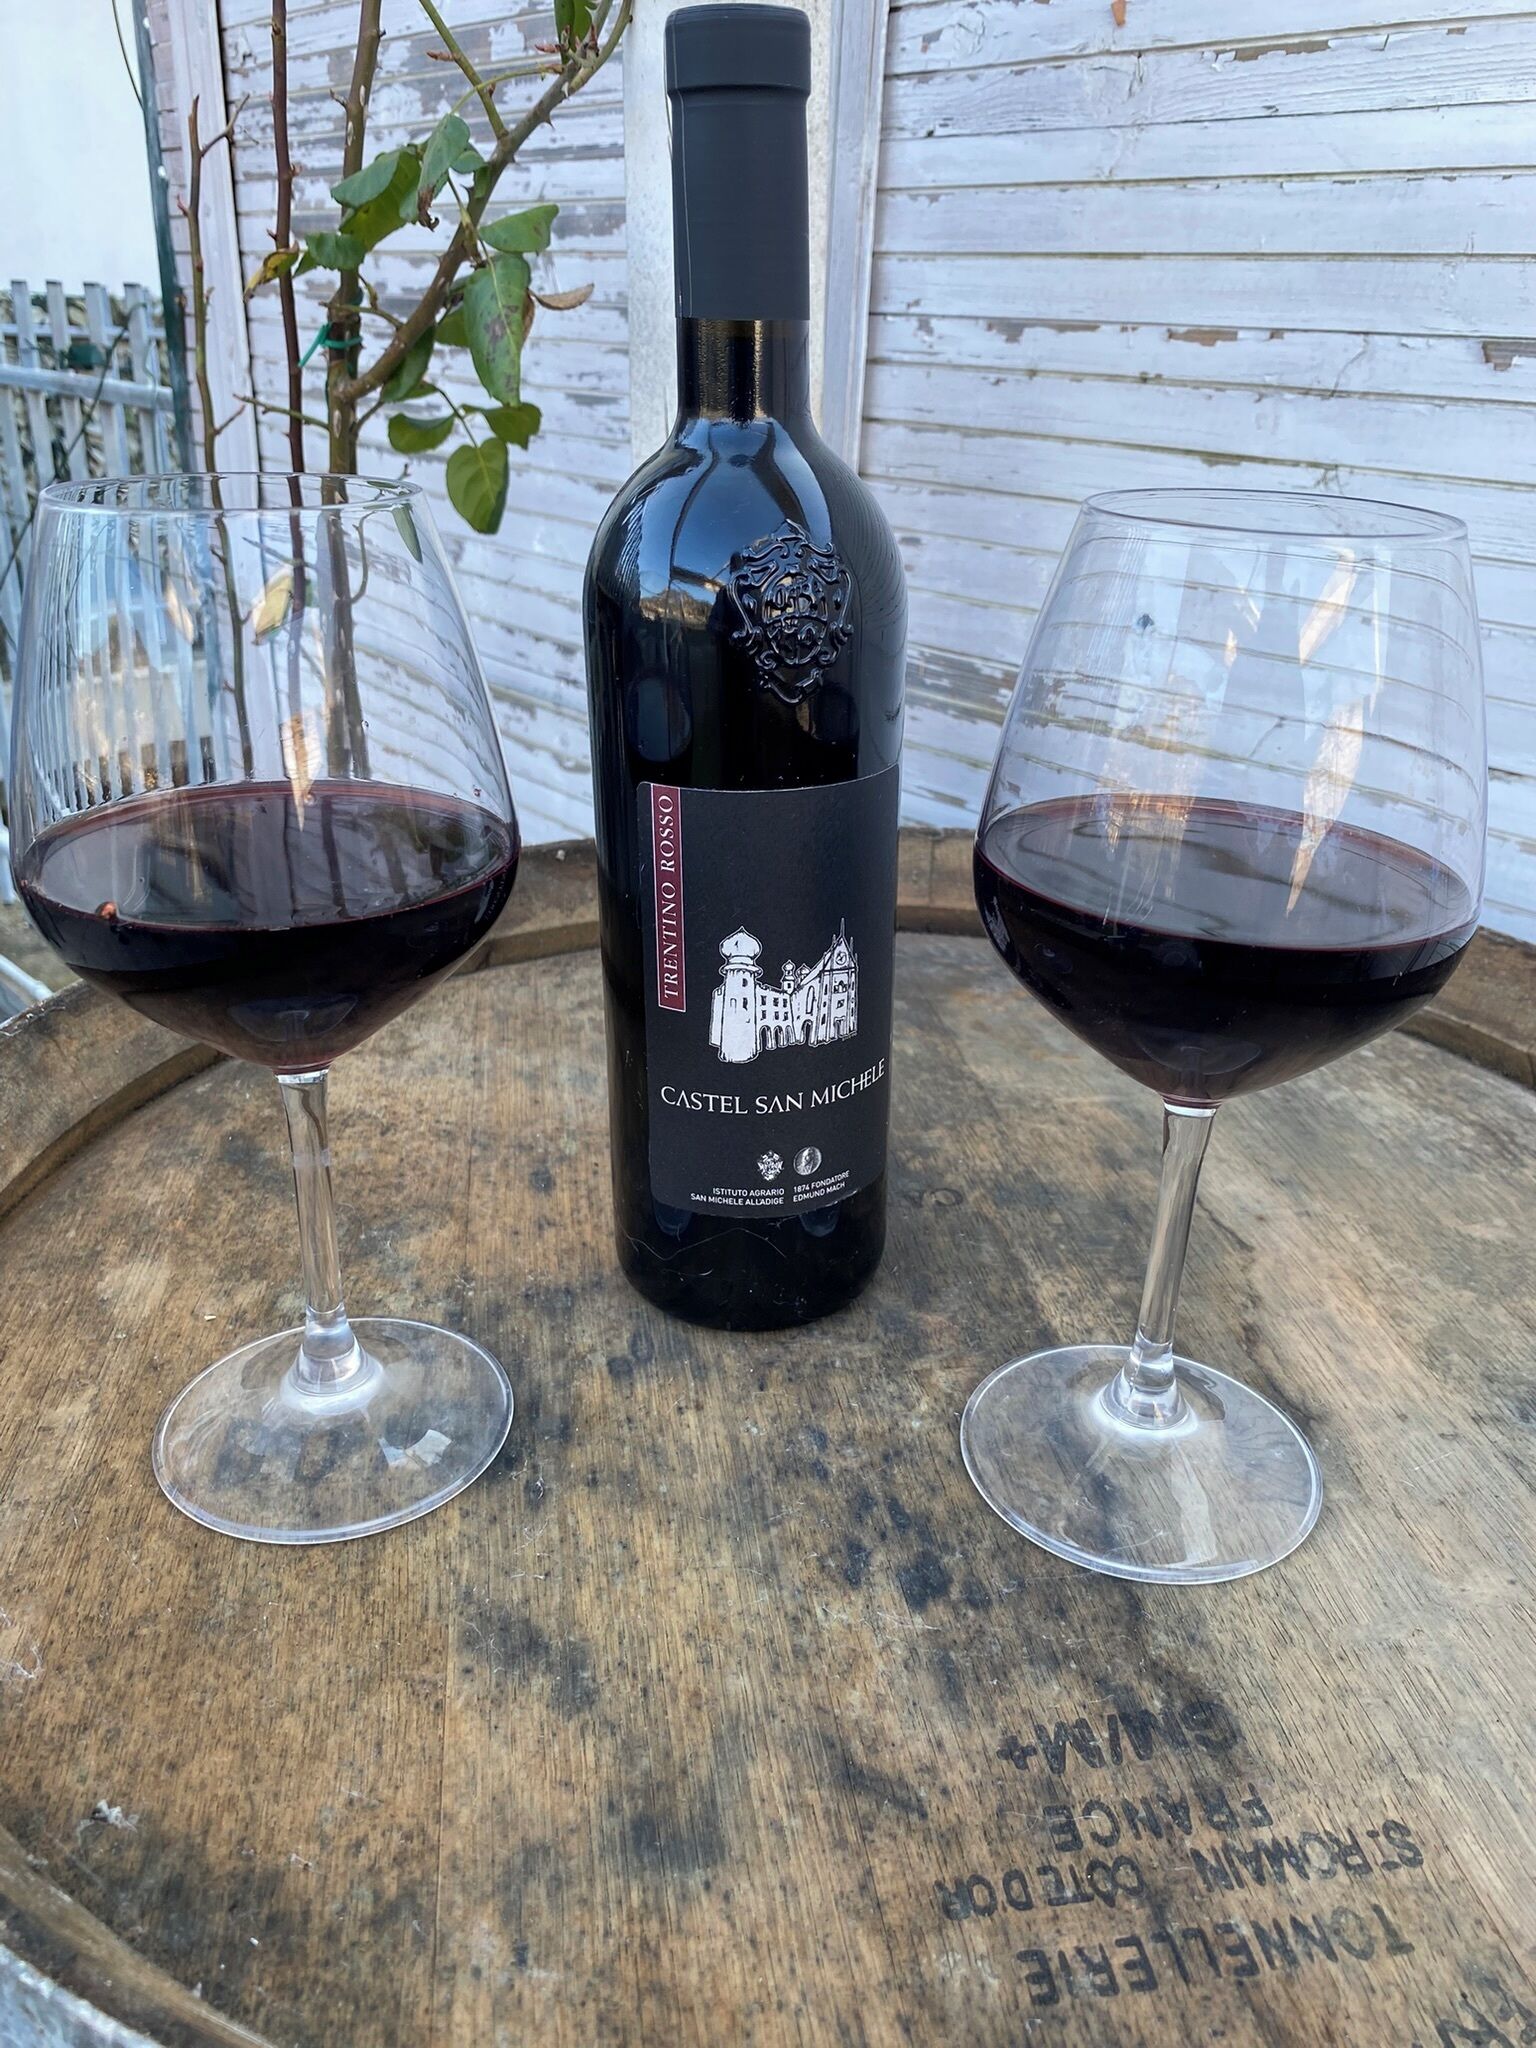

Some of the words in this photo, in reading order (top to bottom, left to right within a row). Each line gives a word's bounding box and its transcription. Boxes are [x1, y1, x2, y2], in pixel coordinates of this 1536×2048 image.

[658, 795, 675, 872] ROSSO
[662, 882, 679, 998] TRENTINO
[661, 1086, 748, 1115] CASTEL
[755, 1093, 804, 1115] SAN
[811, 1058, 885, 1108] MICHELE
[691, 1193, 707, 1202] SAN
[708, 1195, 744, 1206] MICHELE
[712, 1187, 748, 1196] ISTITUTO
[750, 1188, 785, 1197] AGRARIO
[793, 1183, 810, 1193] 1874
[811, 1170, 850, 1190] FONDATORE
[793, 1189, 825, 1203] EDMUND
[826, 1182, 846, 1196] MACH
[1043, 1783, 1274, 1854] FRANCE
[1190, 1823, 1372, 1894] ROMAIN
[1017, 1903, 1415, 2006] TONNELLERIE
